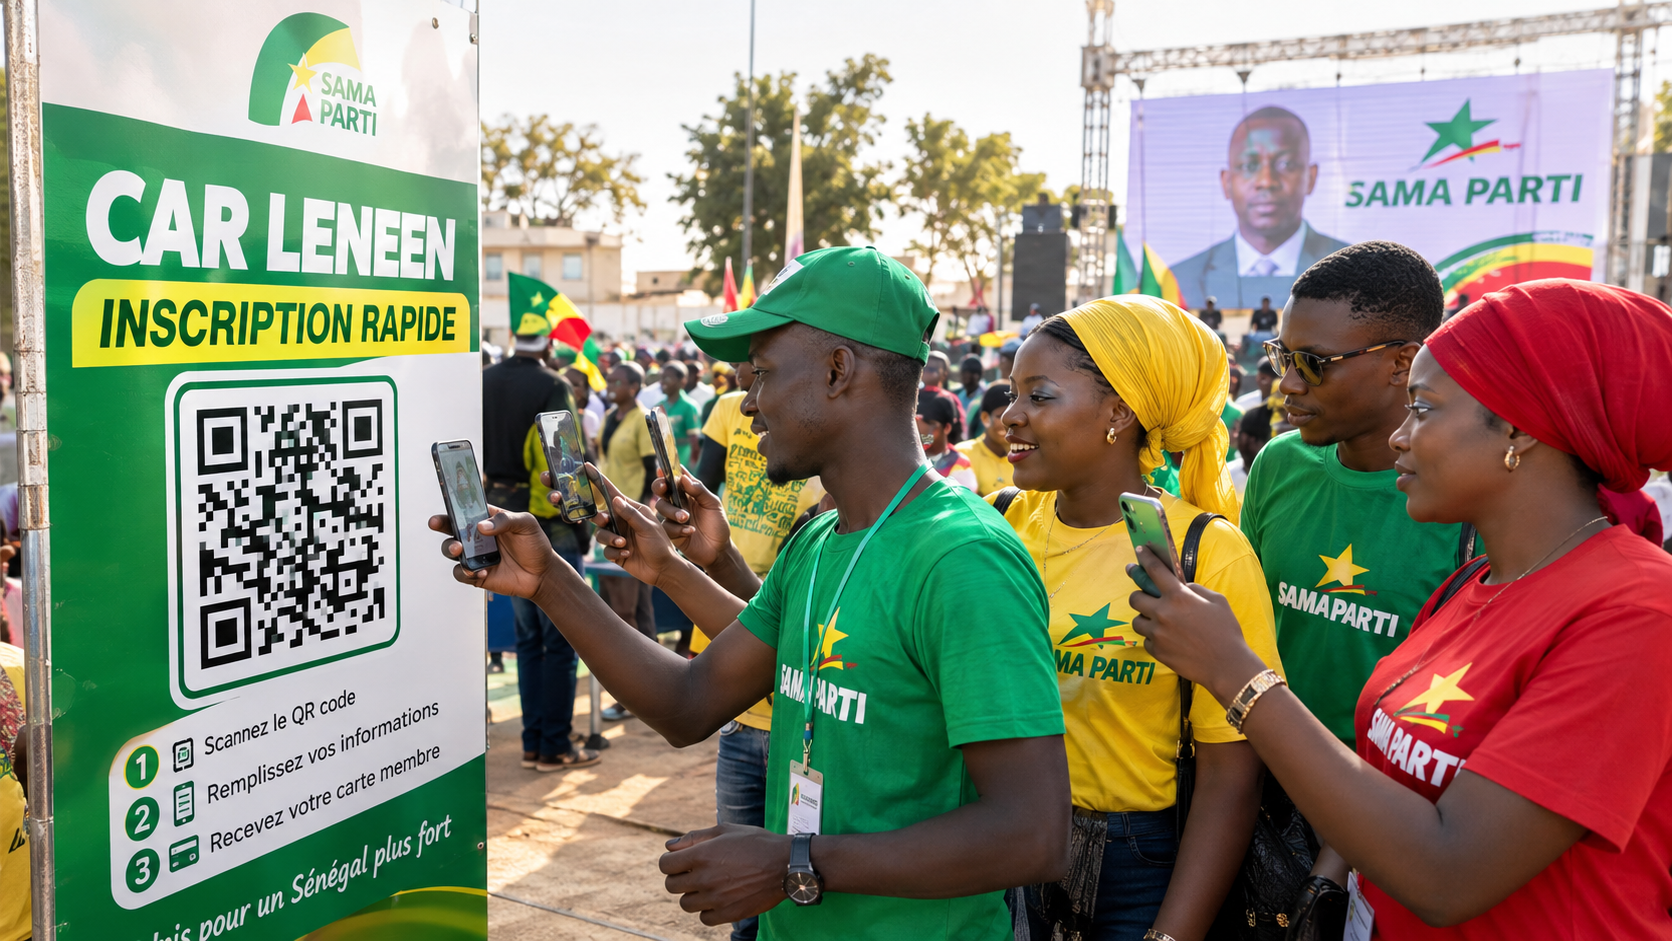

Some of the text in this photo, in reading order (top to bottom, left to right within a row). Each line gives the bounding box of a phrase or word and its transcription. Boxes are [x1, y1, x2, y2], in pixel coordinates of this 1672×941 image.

[320, 99, 377, 136] PARTI
[321, 72, 377, 108] SAMA
[86, 170, 457, 282] CAR LENEEN
[1345, 174, 1584, 208] SAMA PARTI
[99, 299, 457, 349] INSCRIPTION RAPIDE
[1054, 649, 1156, 685] MA PARTI
[134, 702, 440, 835] 2 Remplissez vos informations
[136, 690, 356, 781] 1 Scannez le QR code
[134, 746, 441, 885] 3 Recevez votre carte membre
[198, 903, 251, 941] pour
[257, 891, 285, 918] un
[290, 845, 368, 904] Sénégal
[373, 835, 412, 878] plus
[416, 814, 452, 859] fort
